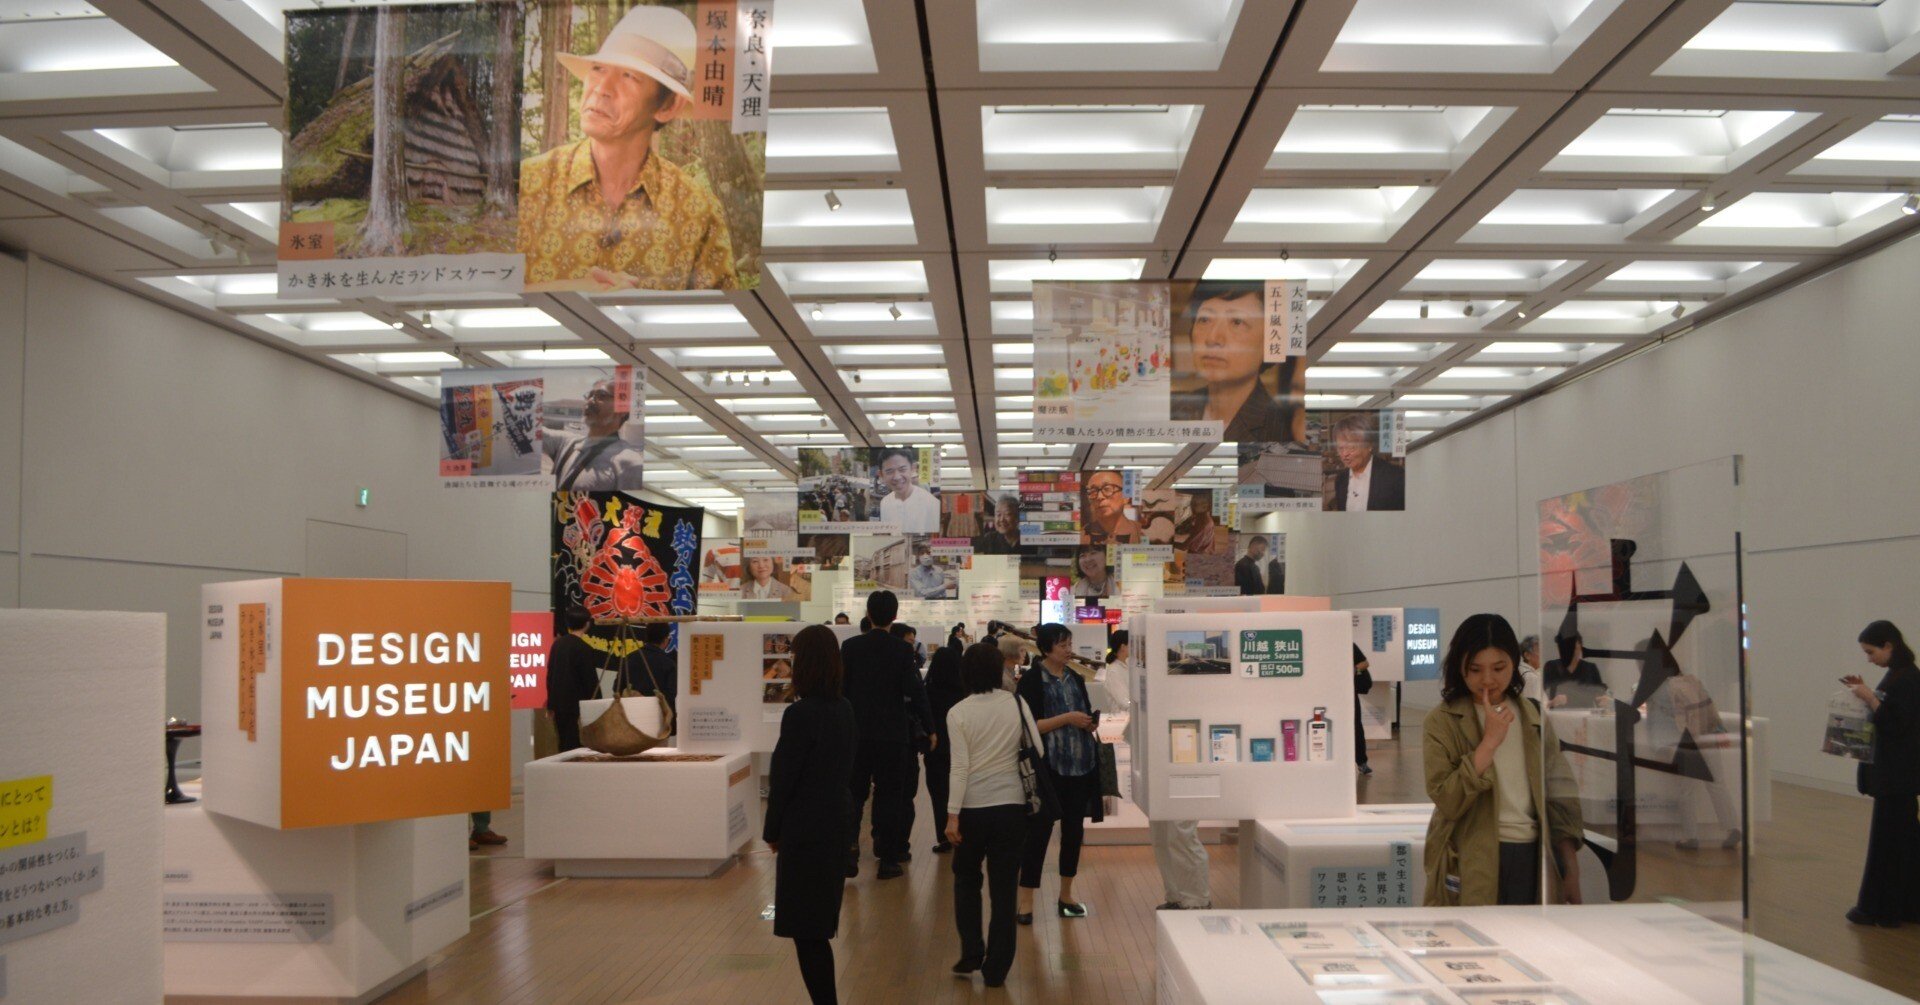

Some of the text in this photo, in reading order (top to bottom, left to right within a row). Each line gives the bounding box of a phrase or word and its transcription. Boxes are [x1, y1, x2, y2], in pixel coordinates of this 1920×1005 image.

[702, 9, 729, 106] 塚本由晴
[740, 6, 767, 118] 奈良・天理
[288, 233, 323, 251] 氷室
[286, 264, 516, 290] かき氷を生んだランドスケープ
[1268, 286, 1283, 356] 五十嵐久枝
[1290, 286, 1304, 350] 大阪・大阪
[1037, 404, 1069, 415] 魔法瓶
[1407, 623, 1437, 635] DESIGN
[317, 631, 482, 667] DESIGN
[1242, 653, 1299, 661] Kawagoe Sayama
[1243, 640, 1299, 652] 川越 狭山
[1406, 638, 1438, 650] MUSEUM
[1245, 664, 1254, 676] 4
[1276, 664, 1301, 674] 500m
[1411, 653, 1435, 666] JAPAN
[306, 681, 491, 719] MUSEUM
[330, 731, 471, 771] JAPAN
[1, 786, 45, 807] にとって
[1336, 872, 1348, 906] 思い浮
[1356, 872, 1367, 908] になっ
[1377, 871, 1387, 905] 世界の
